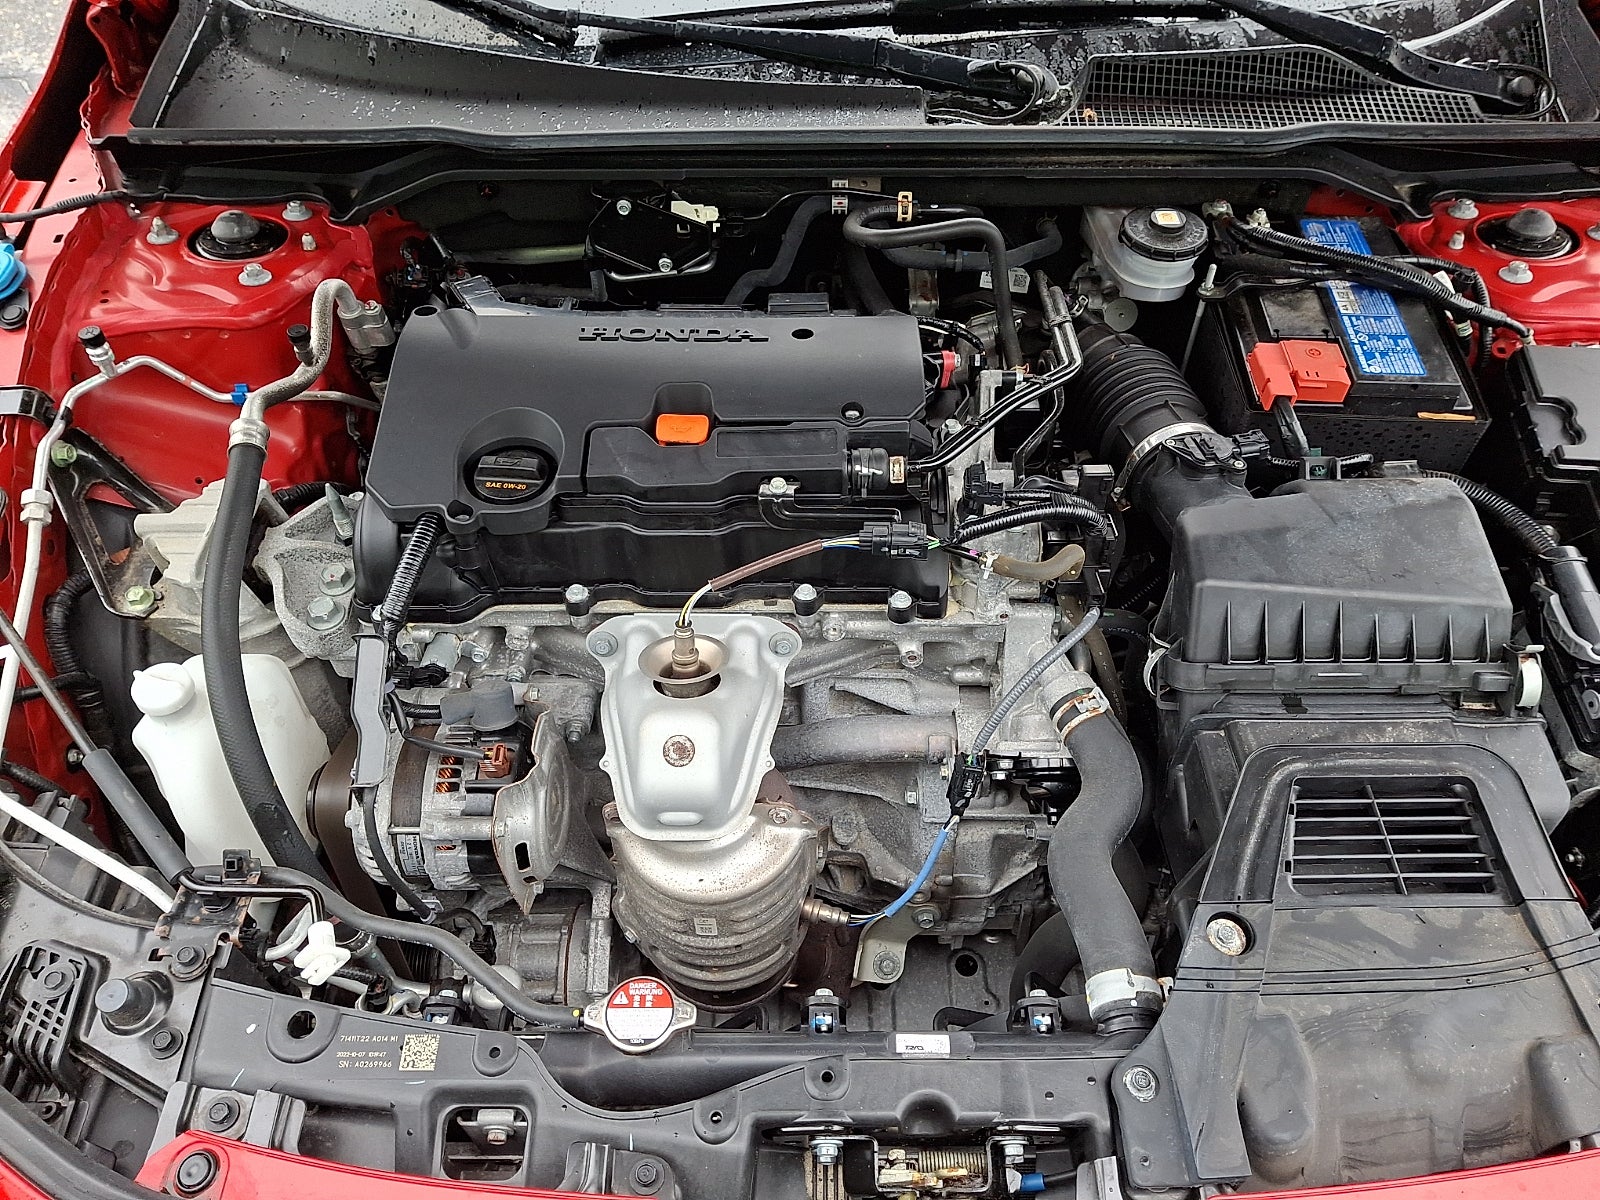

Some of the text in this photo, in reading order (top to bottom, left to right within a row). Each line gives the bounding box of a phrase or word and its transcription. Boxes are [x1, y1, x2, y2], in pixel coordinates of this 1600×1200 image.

[578, 327, 770, 342] HONDA
[485, 481, 527, 490] SAE 0W-20
[338, 1060, 392, 1068] SN: A0269966
